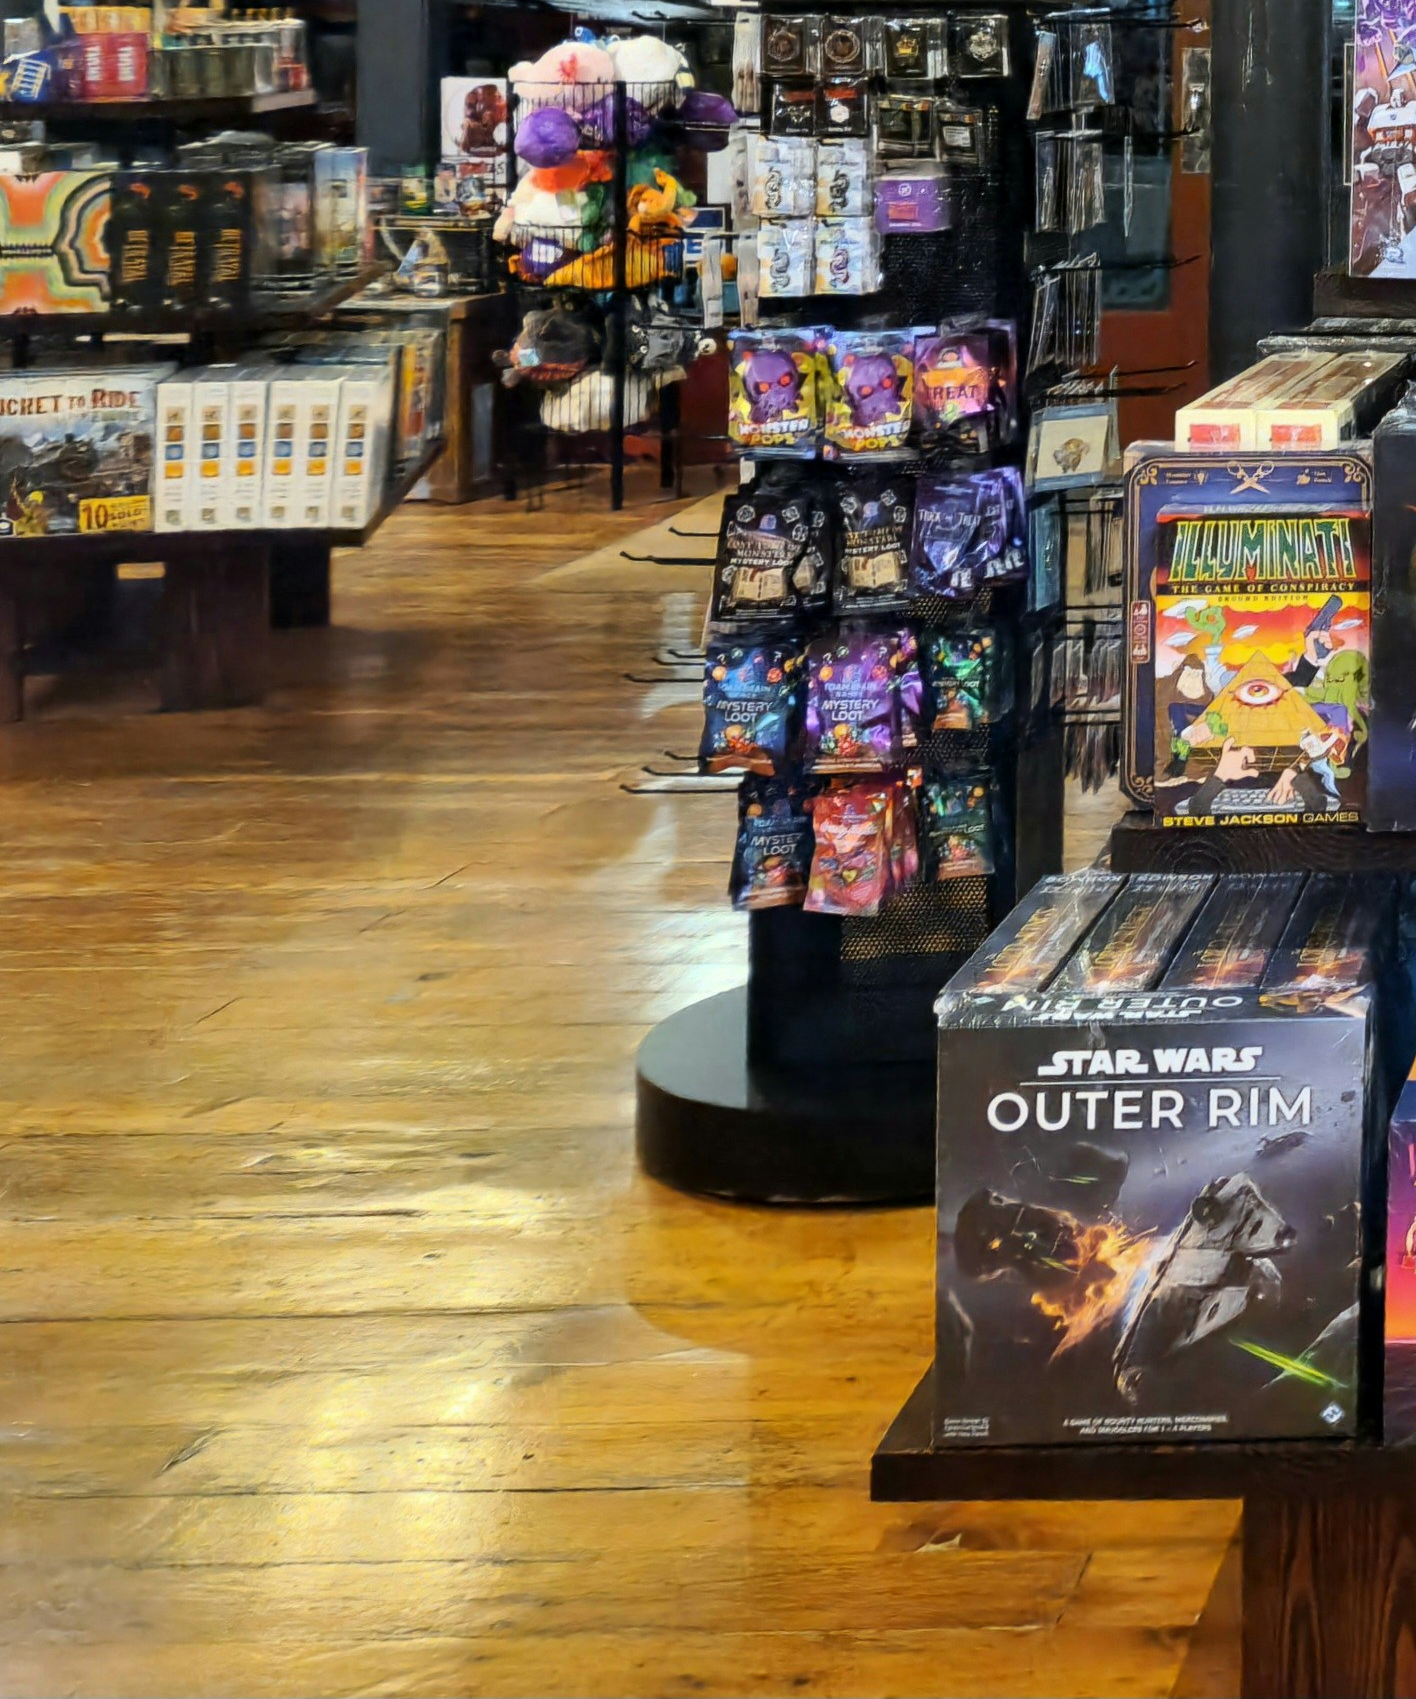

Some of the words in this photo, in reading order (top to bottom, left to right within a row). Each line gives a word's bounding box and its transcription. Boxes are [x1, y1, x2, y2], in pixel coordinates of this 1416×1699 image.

[0, 394, 62, 417] ICKET
[92, 388, 144, 410] RIDE
[82, 503, 108, 530] 10
[1168, 518, 1357, 582] ILLUMINATI
[1172, 585, 1198, 594] THE
[1205, 584, 1240, 593] GAME
[1247, 584, 1264, 593] OF
[1270, 582, 1355, 592] CONSPIRACY
[716, 700, 772, 712] MYSTERY
[821, 699, 880, 711] MYSTERY
[724, 712, 757, 722] LOOT
[832, 711, 864, 722] LOOT
[1162, 815, 1215, 827] STEVE
[1220, 813, 1298, 826] JACKSON
[1303, 811, 1360, 825] GAMES
[764, 844, 798, 856] LOOT
[1099, 995, 1243, 1009] OUTER
[1038, 1049, 1148, 1075] STAR
[1153, 1046, 1262, 1073] WARS
[987, 1089, 1184, 1132] OUTER
[1208, 1086, 1312, 1128] RIM
